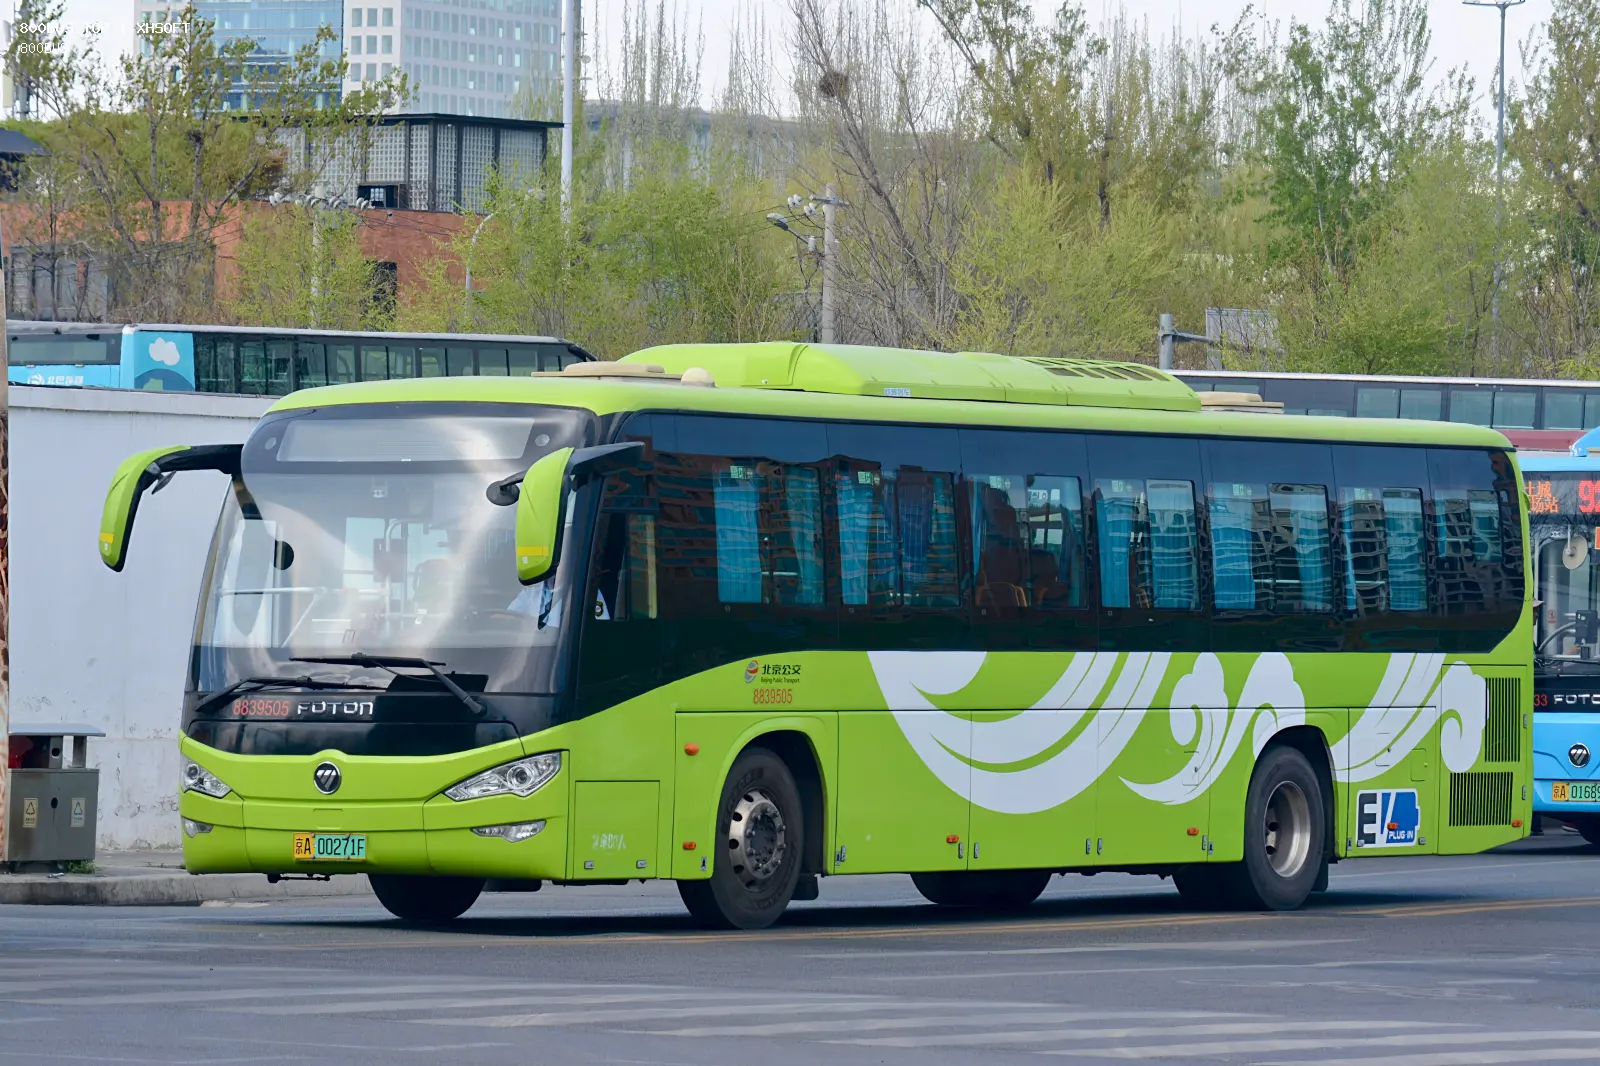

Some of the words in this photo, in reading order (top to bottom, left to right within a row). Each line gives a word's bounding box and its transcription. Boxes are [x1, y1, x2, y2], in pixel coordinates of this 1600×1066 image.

[1528, 496, 1559, 514] 场站
[762, 664, 801, 675] 北京公交
[753, 688, 793, 705] 8839505
[232, 699, 290, 717] 8839505
[297, 701, 374, 716] FOTON
[1388, 831, 1414, 839] PLUG-IN
